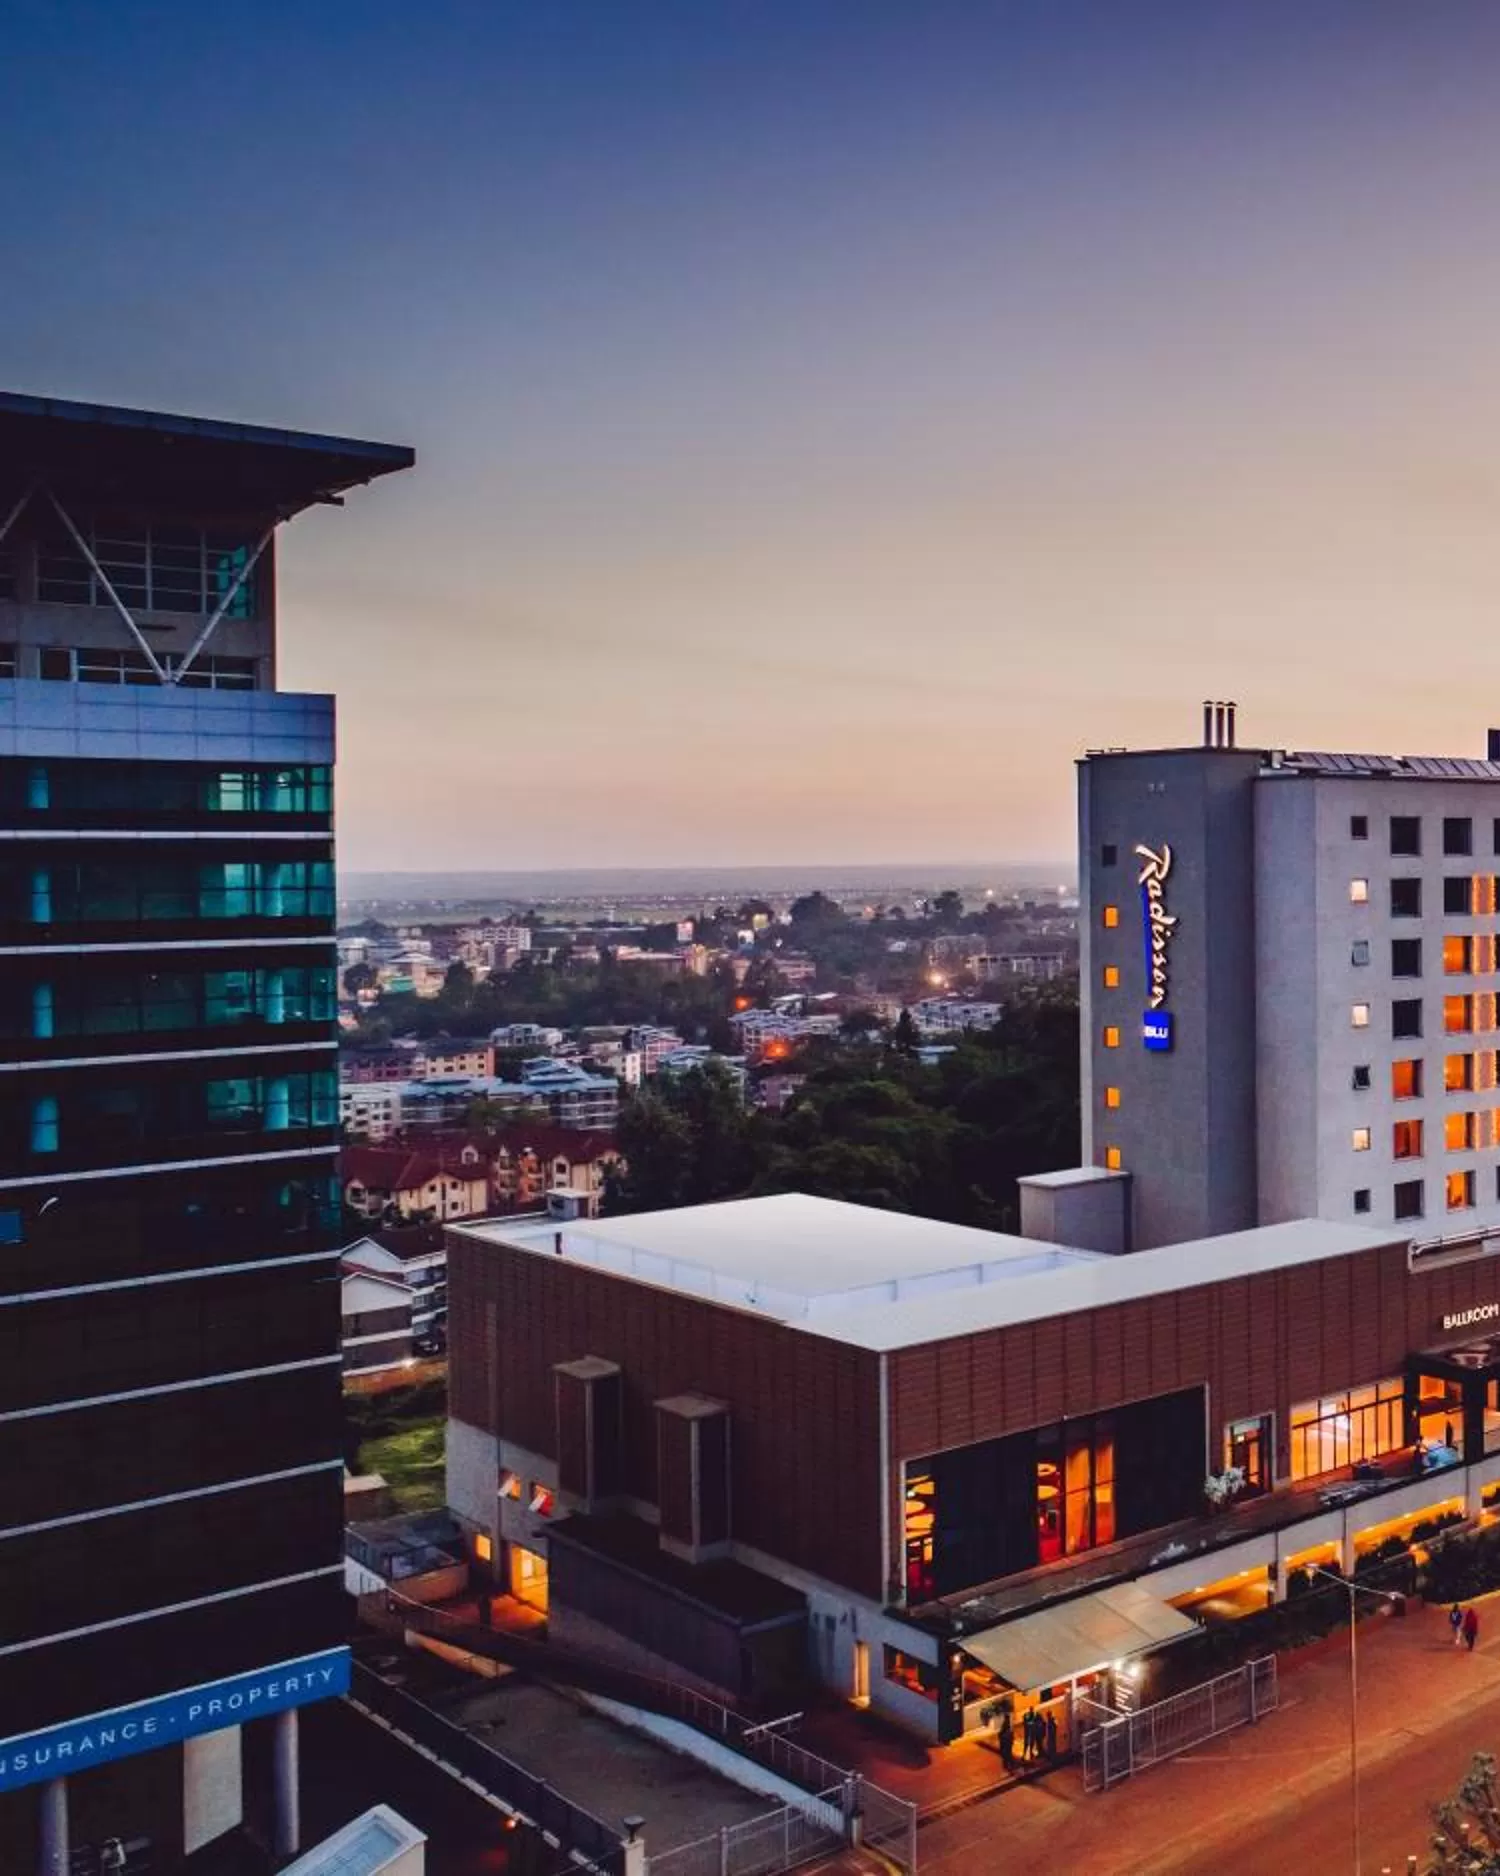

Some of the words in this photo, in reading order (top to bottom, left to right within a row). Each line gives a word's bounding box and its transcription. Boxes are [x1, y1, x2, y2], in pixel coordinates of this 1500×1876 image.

[1134, 843, 1177, 1009] Radisson
[1443, 1303, 1499, 1329] BALLROOM
[189, 1667, 334, 1721] PROPERTY
